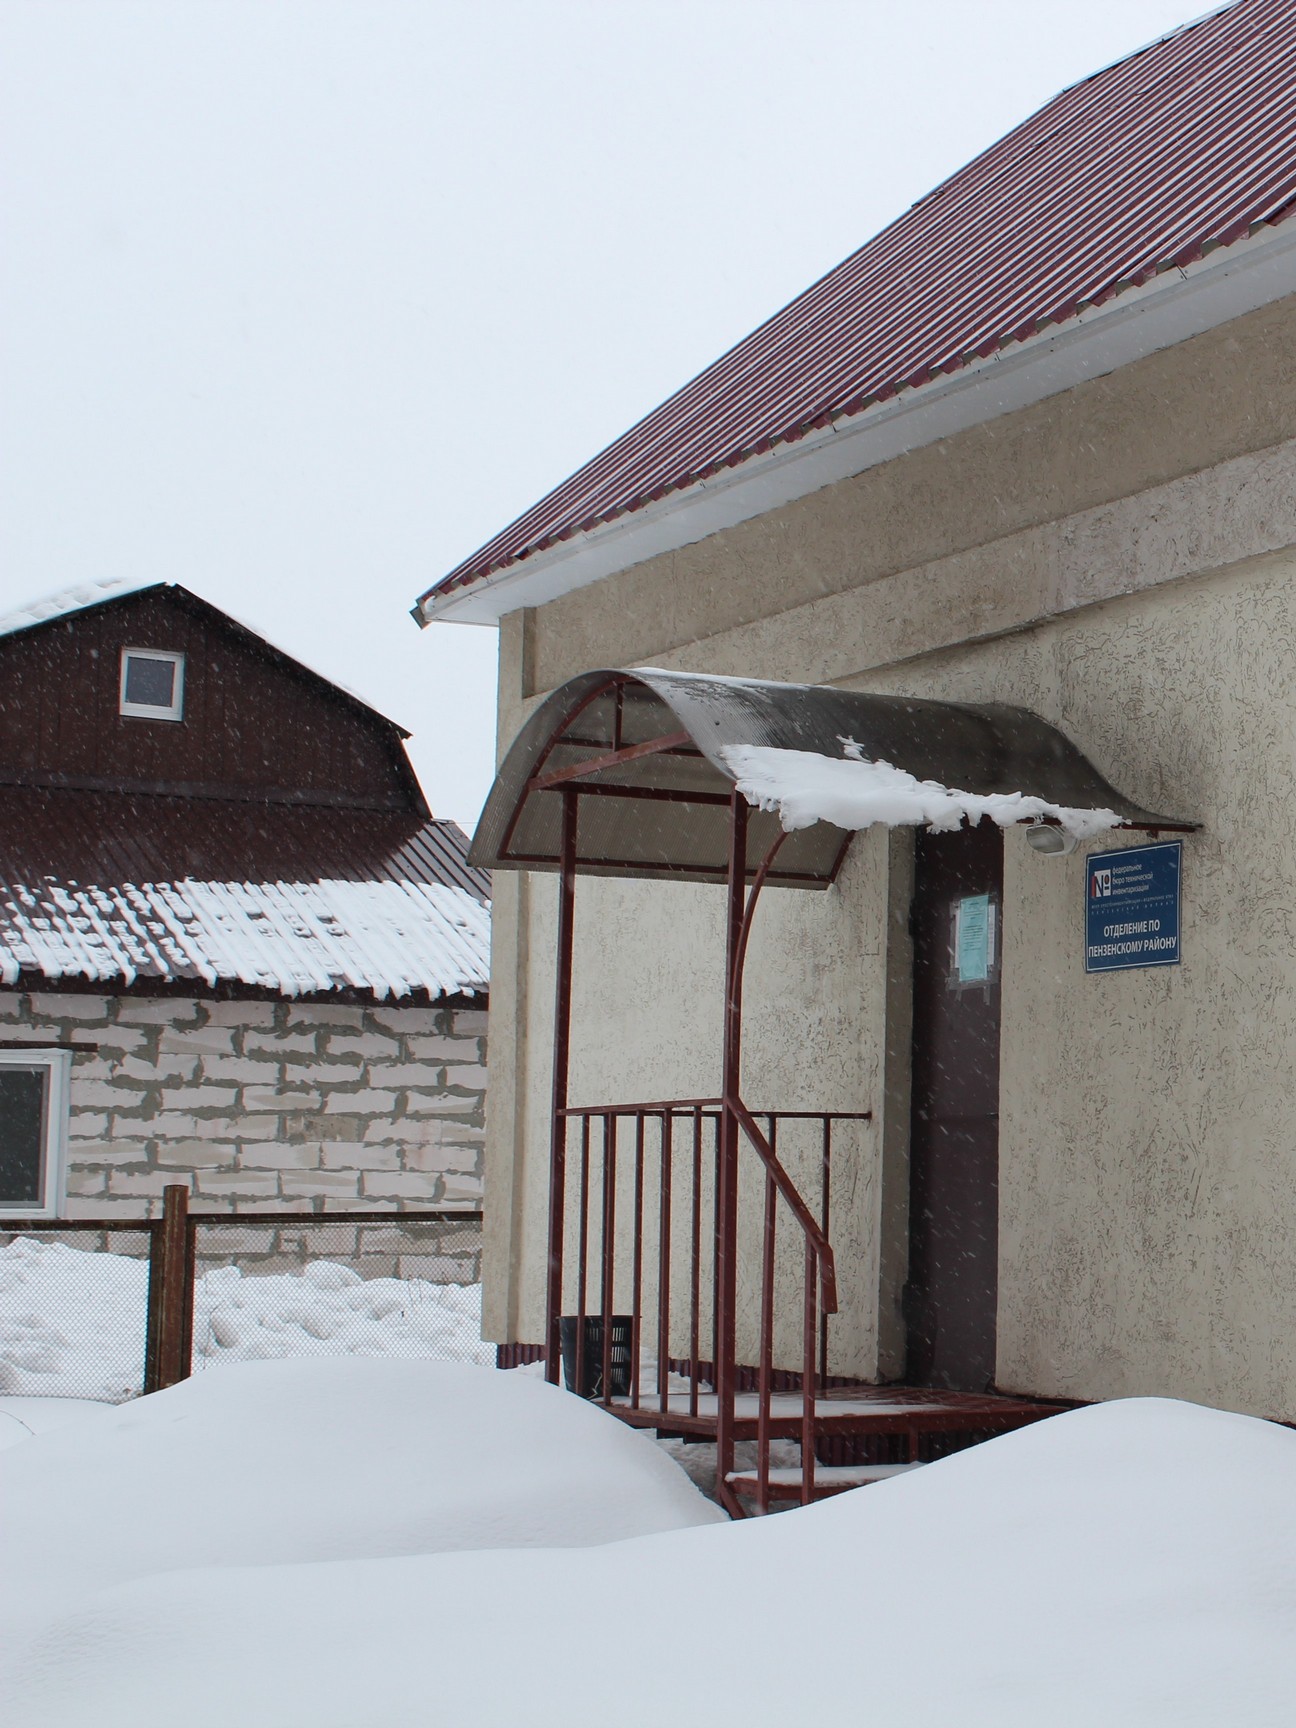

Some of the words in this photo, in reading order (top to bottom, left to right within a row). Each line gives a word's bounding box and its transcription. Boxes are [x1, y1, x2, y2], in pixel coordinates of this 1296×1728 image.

[1112, 864, 1142, 875] федеральное
[1112, 877, 1125, 886] бюро
[1125, 871, 1153, 883] технической
[1103, 921, 1147, 939] ОТДЕЛЕНИЕ
[1148, 919, 1160, 932] ПО
[1088, 940, 1143, 958] ПЕНЗЕНСКОМУ
[1143, 936, 1177, 951] РАЙОНУ
